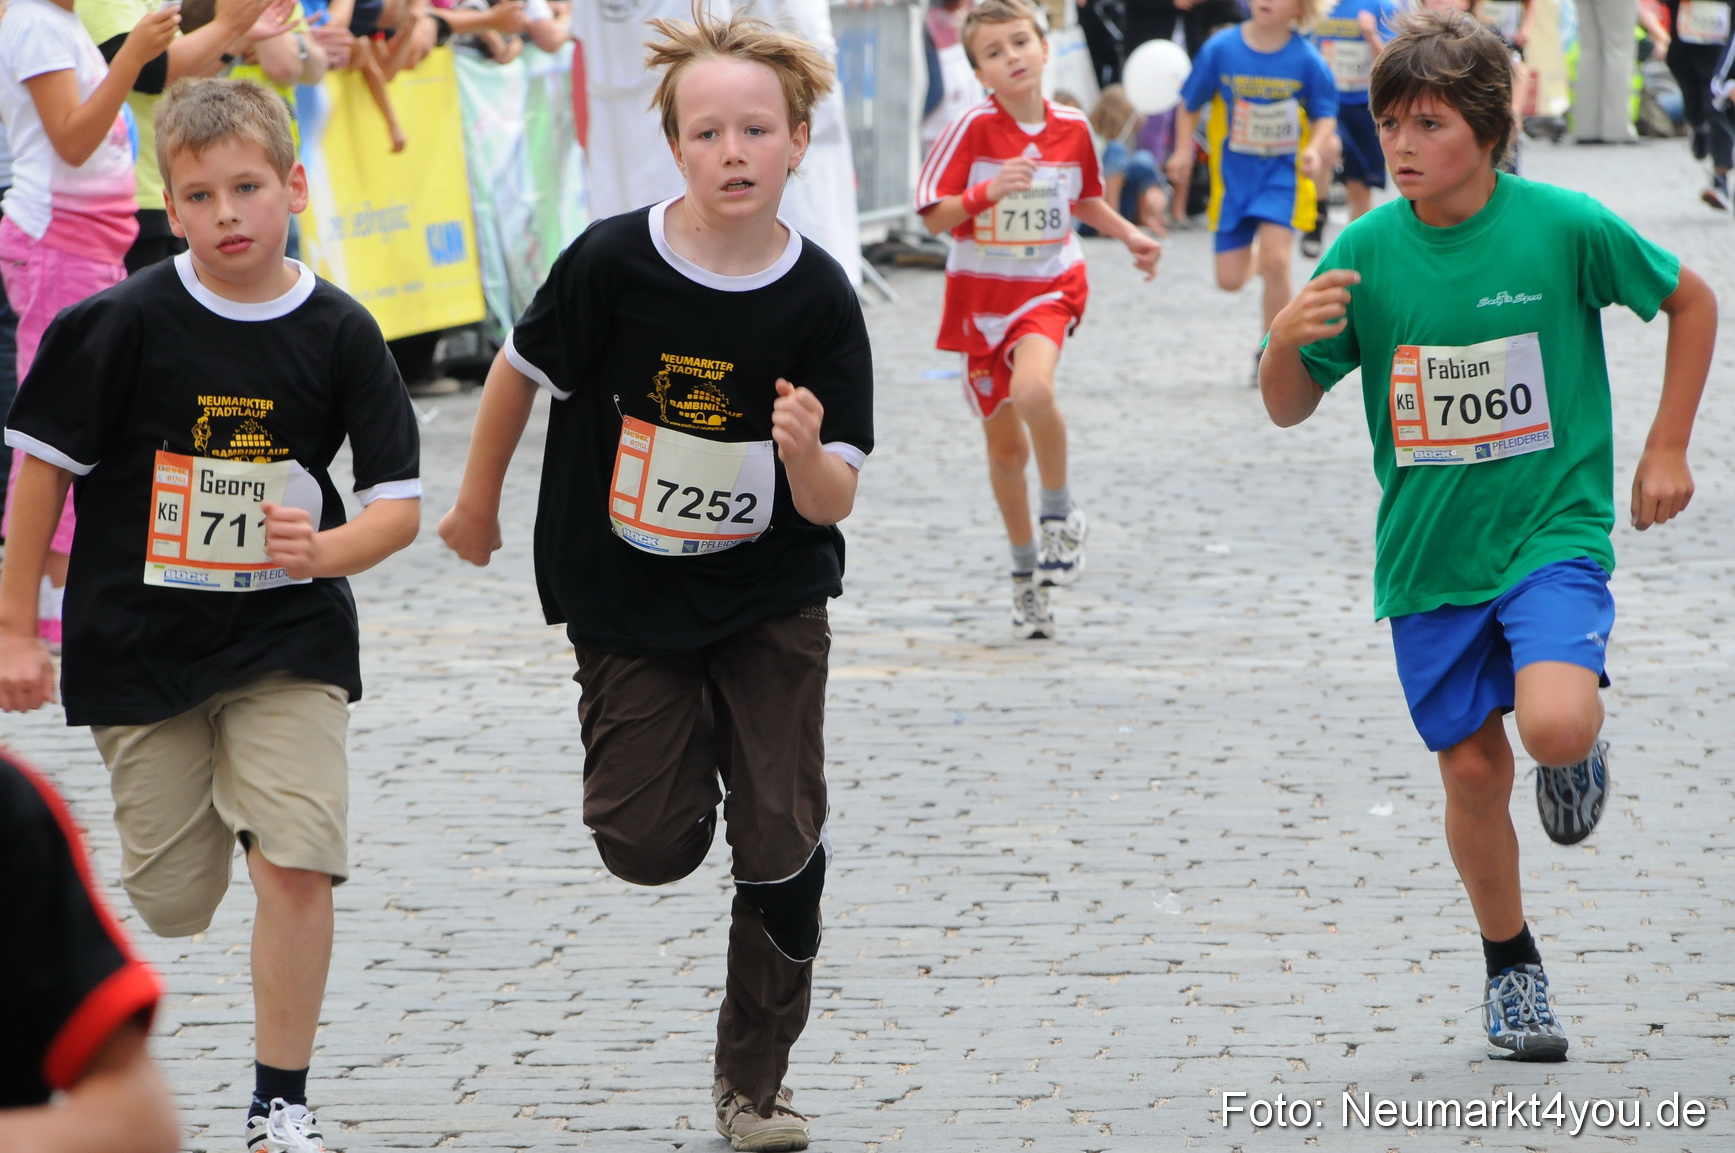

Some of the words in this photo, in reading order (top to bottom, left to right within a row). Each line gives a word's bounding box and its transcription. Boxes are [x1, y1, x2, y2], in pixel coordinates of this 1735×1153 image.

[1003, 208, 1061, 231] 7138
[661, 353, 734, 371] NEUMARKTER
[665, 364, 725, 380] STADTLAUF
[1427, 357, 1490, 379] Fabian
[198, 395, 274, 410] NEUMARKTER
[670, 400, 743, 417] BAMBINILAUF
[1397, 394, 1415, 410] K6
[1433, 383, 1532, 426] 7060
[203, 406, 267, 419] STADTLAUF
[1492, 431, 1550, 451] PFLEIDERER
[201, 469, 266, 502] Georg
[656, 479, 758, 524] 7252
[158, 502, 178, 522] K6
